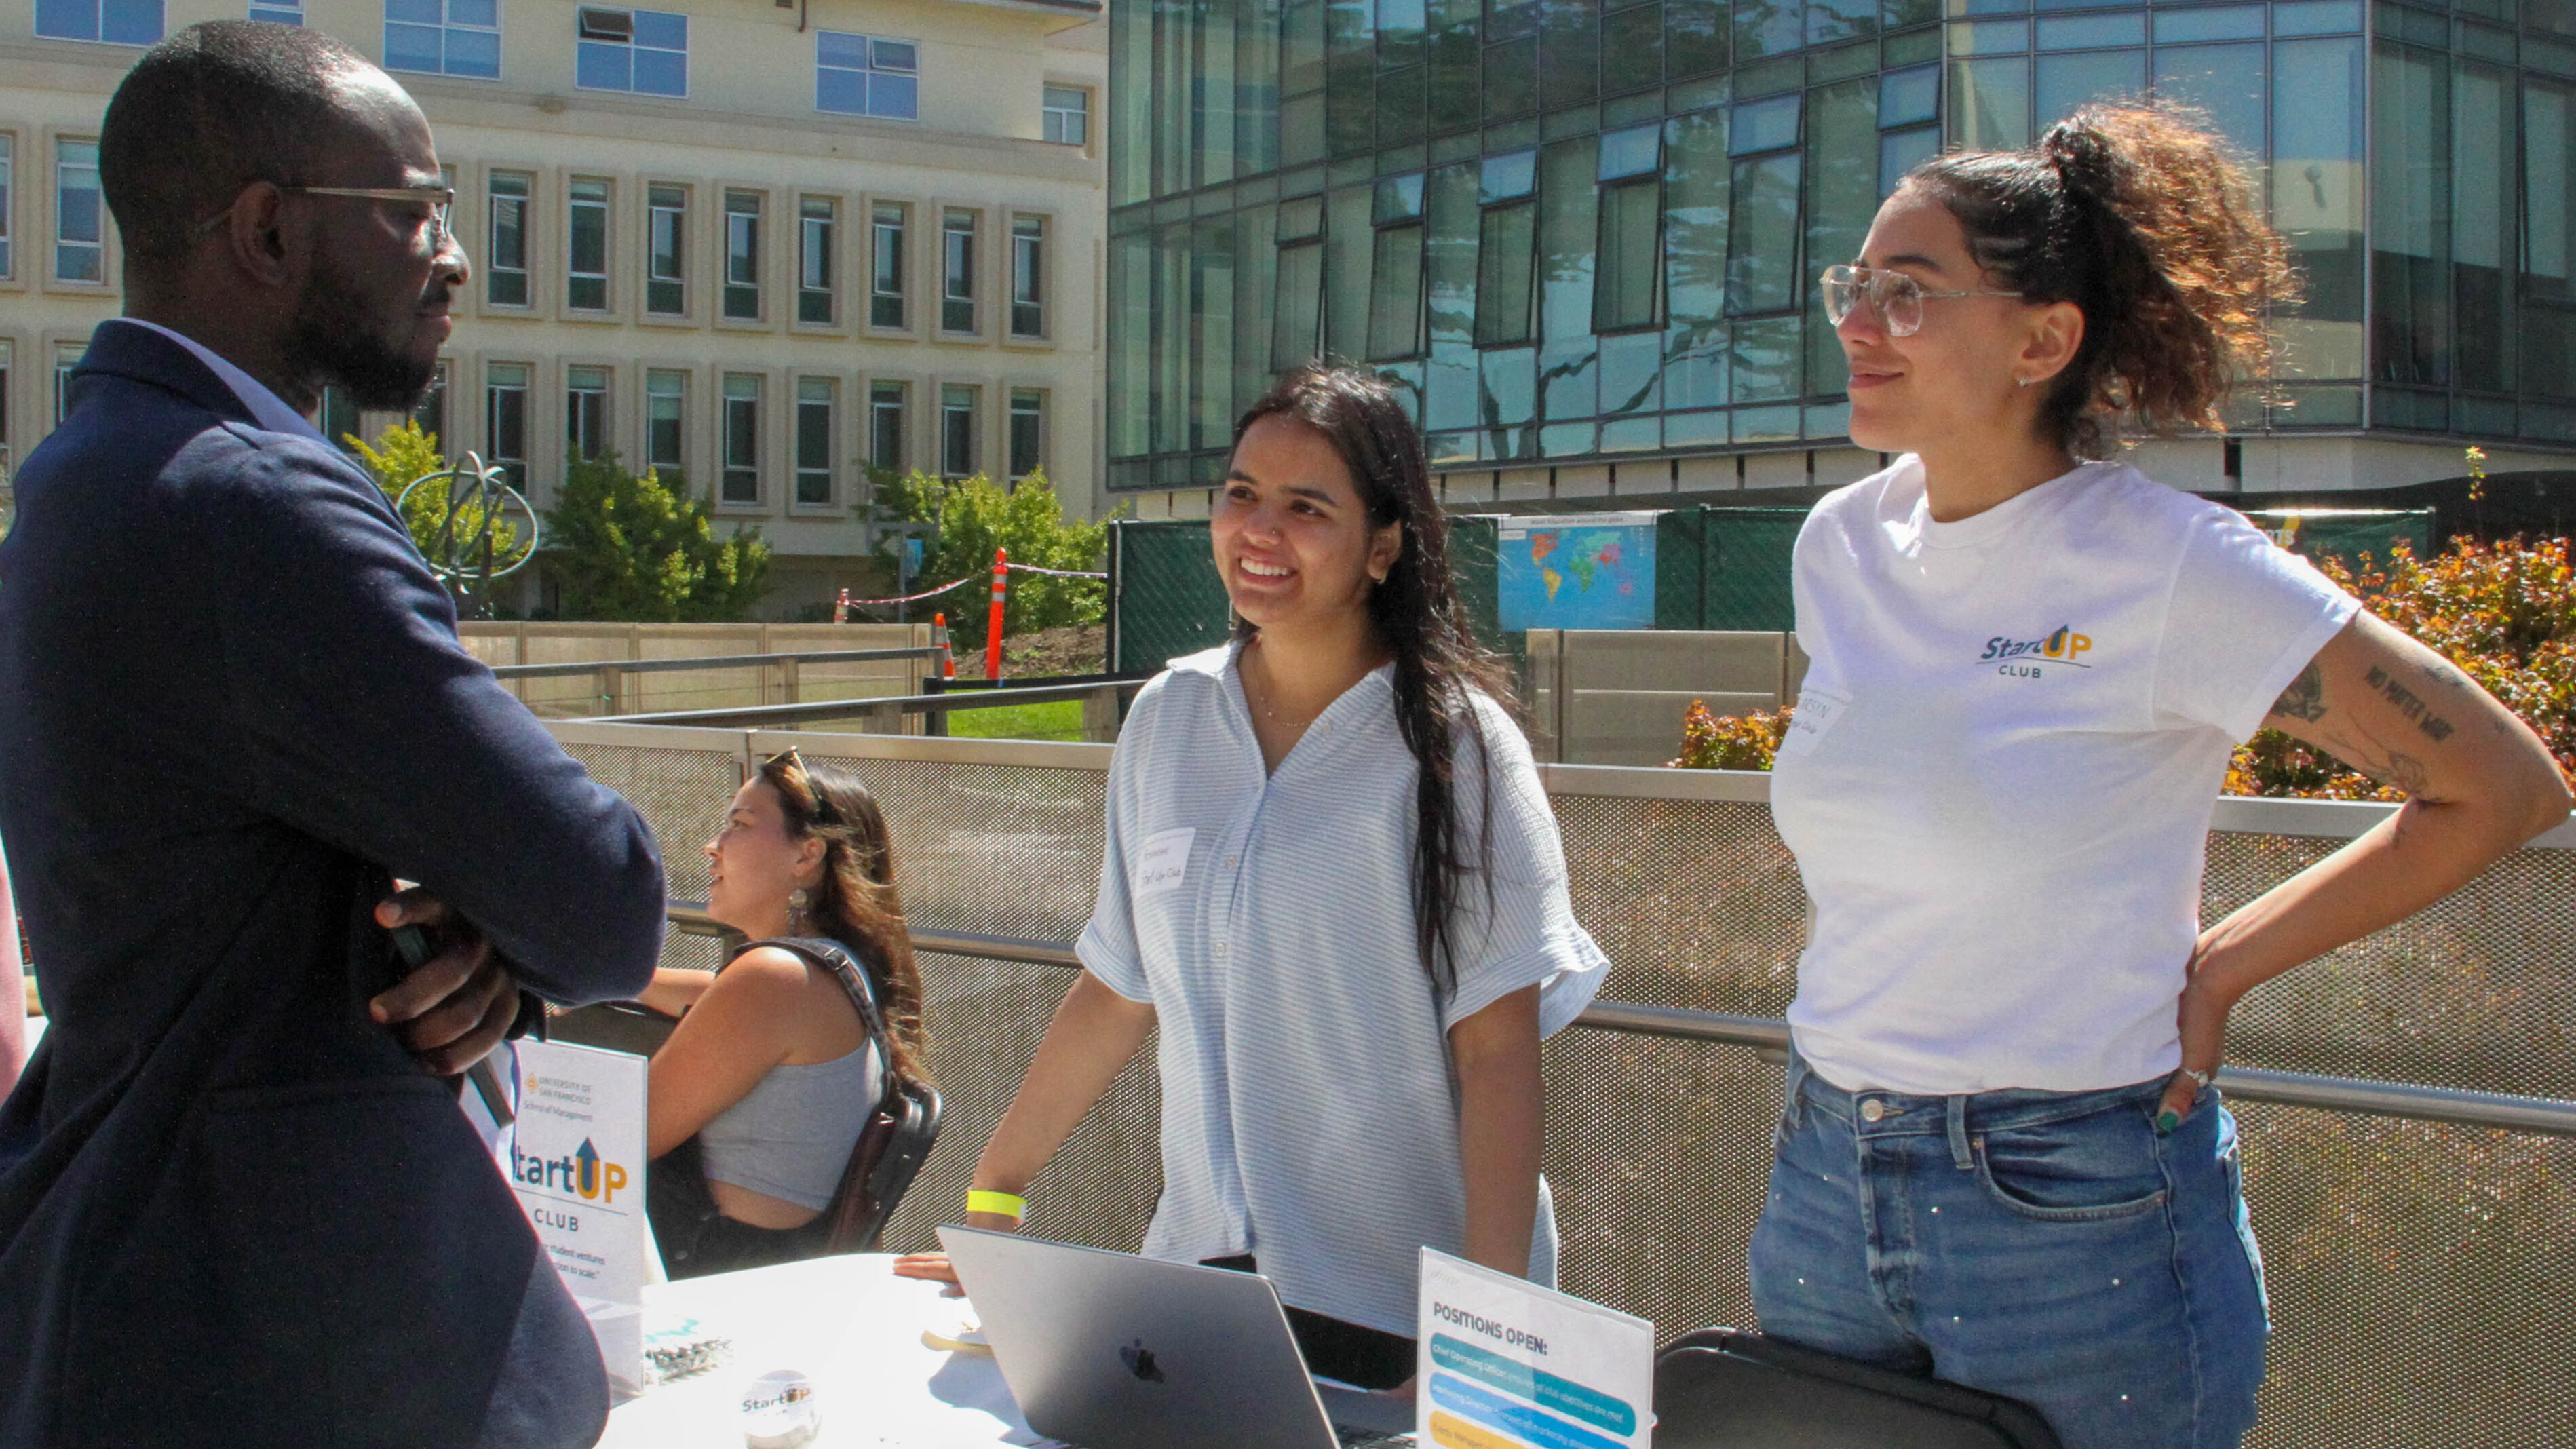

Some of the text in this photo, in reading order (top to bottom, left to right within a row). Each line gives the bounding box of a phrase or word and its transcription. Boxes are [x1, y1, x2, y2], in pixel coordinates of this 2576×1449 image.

[2266, 529, 2295, 545] RTS
[1981, 629, 2092, 659] StartUP
[1999, 665, 2041, 678] CLUB
[539, 1076, 592, 1093] UNIVERSITY OF
[540, 1087, 592, 1106] SAN FRANCISCO
[516, 1140, 628, 1203] tartUP
[534, 1208, 579, 1232] CLUB
[1434, 1301, 1547, 1355] POSITIONS OPEN:
[742, 1386, 811, 1412] StartUP
